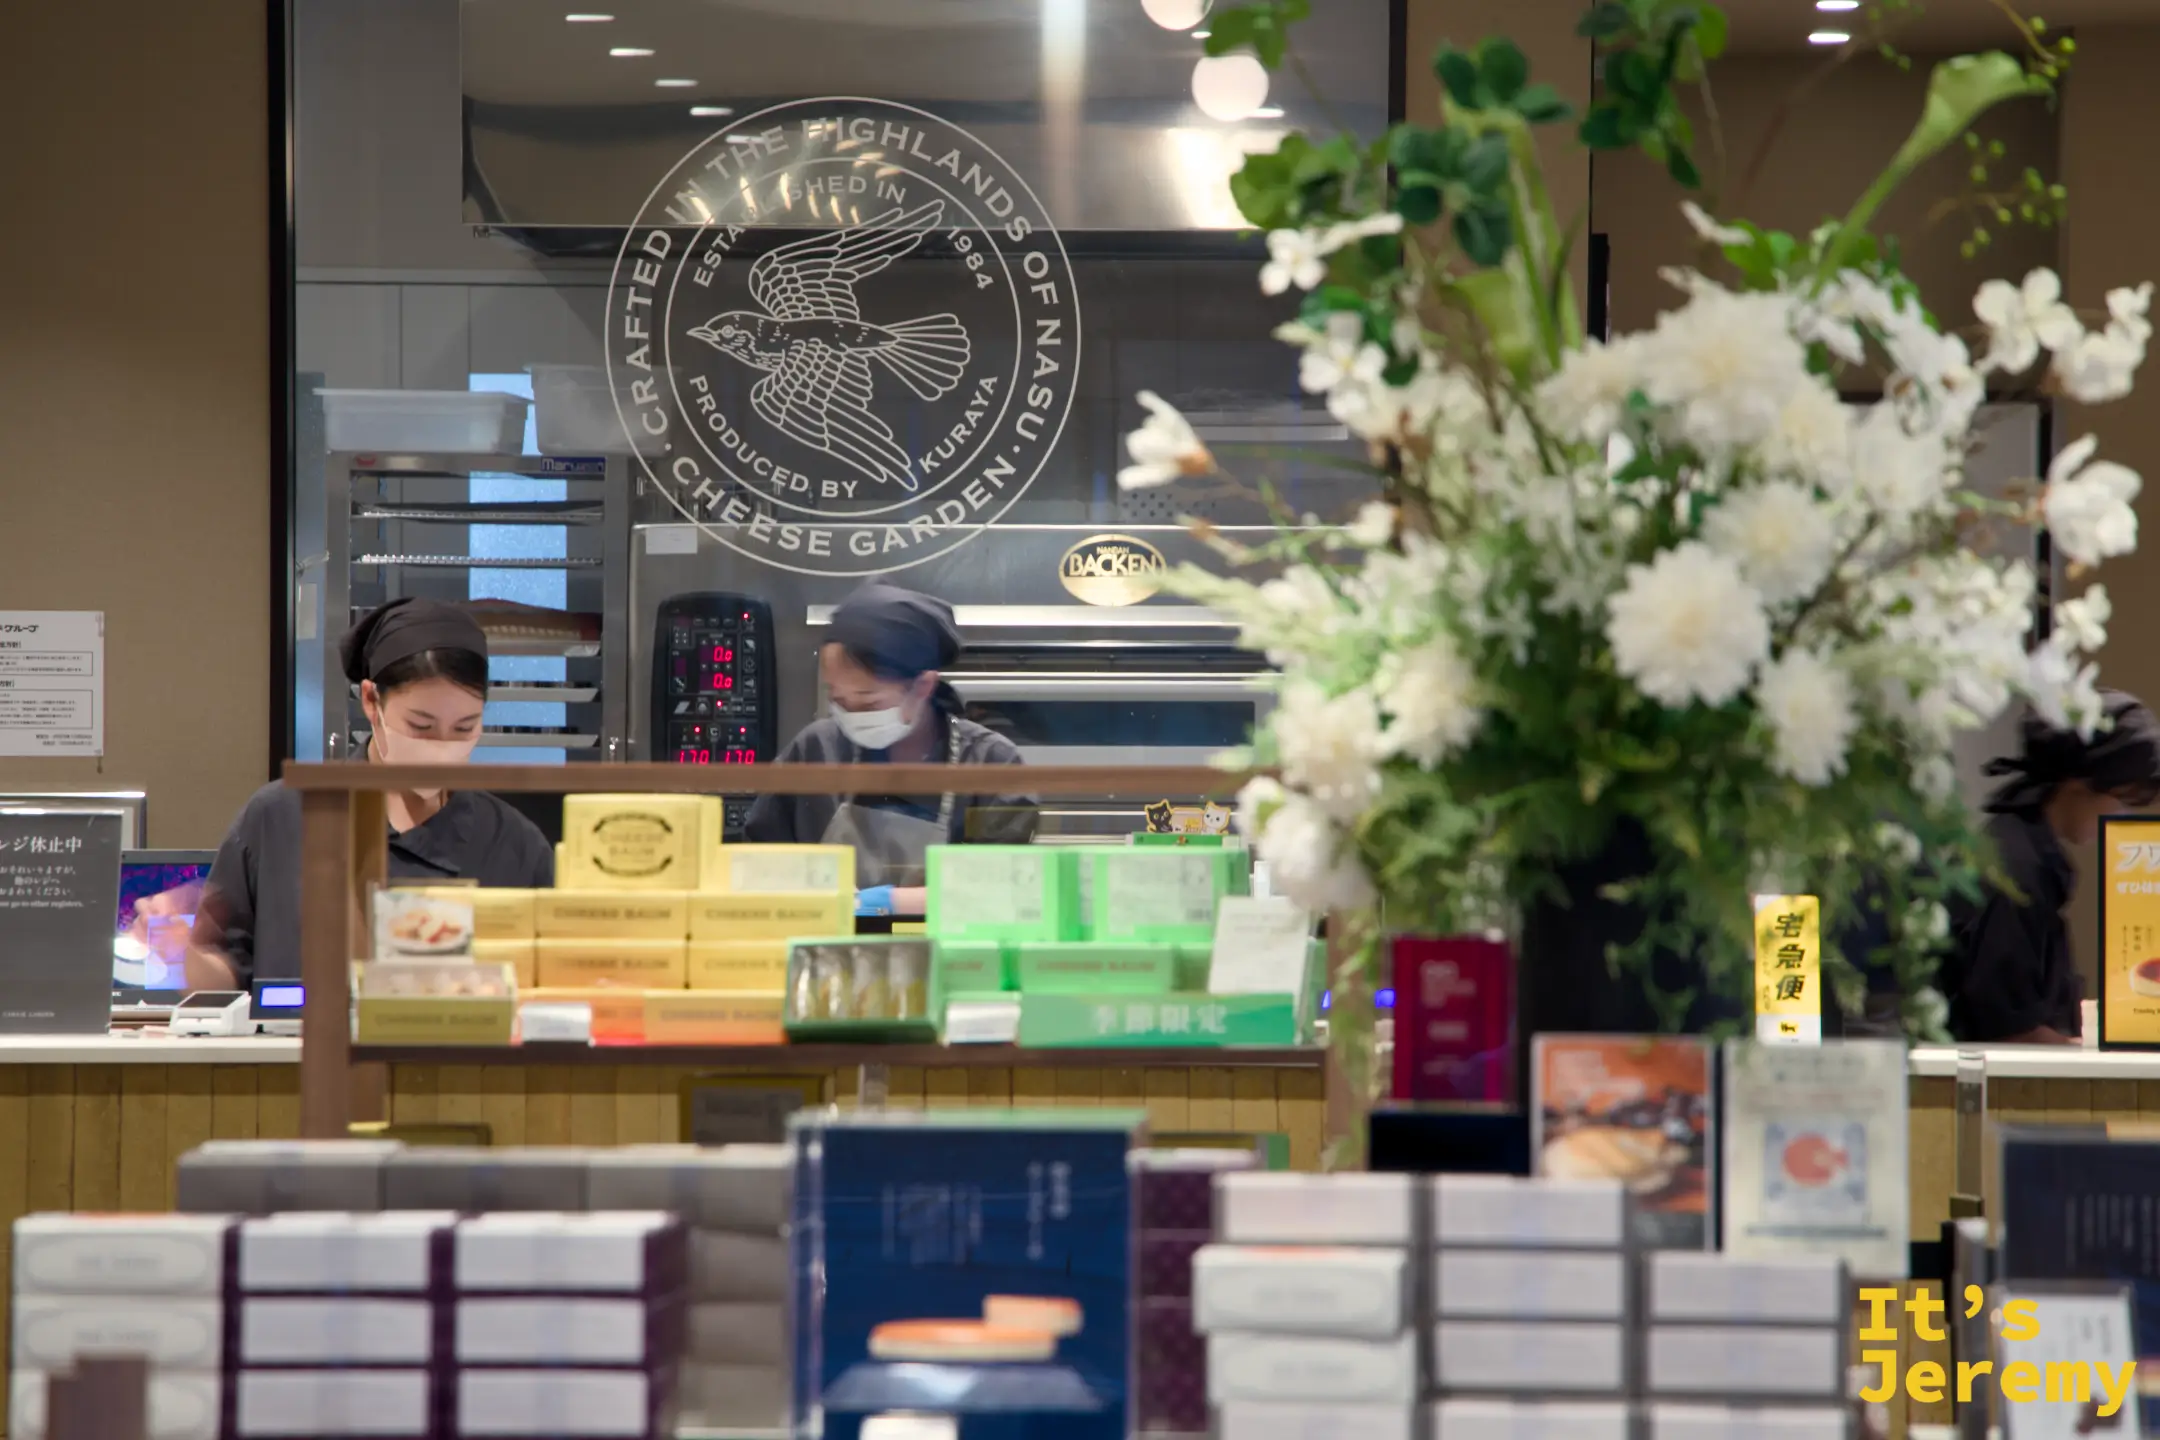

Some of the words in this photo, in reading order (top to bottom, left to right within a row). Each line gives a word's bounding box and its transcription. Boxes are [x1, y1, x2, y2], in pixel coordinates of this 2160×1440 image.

[705, 125, 789, 180] THE
[801, 117, 1032, 242] HIGHLANDS
[877, 181, 906, 204] IN
[947, 226, 994, 290] 1984
[1023, 251, 1059, 304] OF
[625, 230, 672, 436] CRAFTED
[1016, 319, 1061, 441] NASU
[690, 375, 809, 492] PRODUCED
[821, 480, 858, 498] BY
[919, 376, 998, 474] KURAYA
[673, 457, 832, 556] CHEESE
[849, 454, 1017, 556] GARDEN
[1069, 553, 1157, 576] BACKEN
[680, 749, 709, 764] 170
[725, 749, 755, 764] 170
[1775, 913, 1805, 1001] 宅急便
